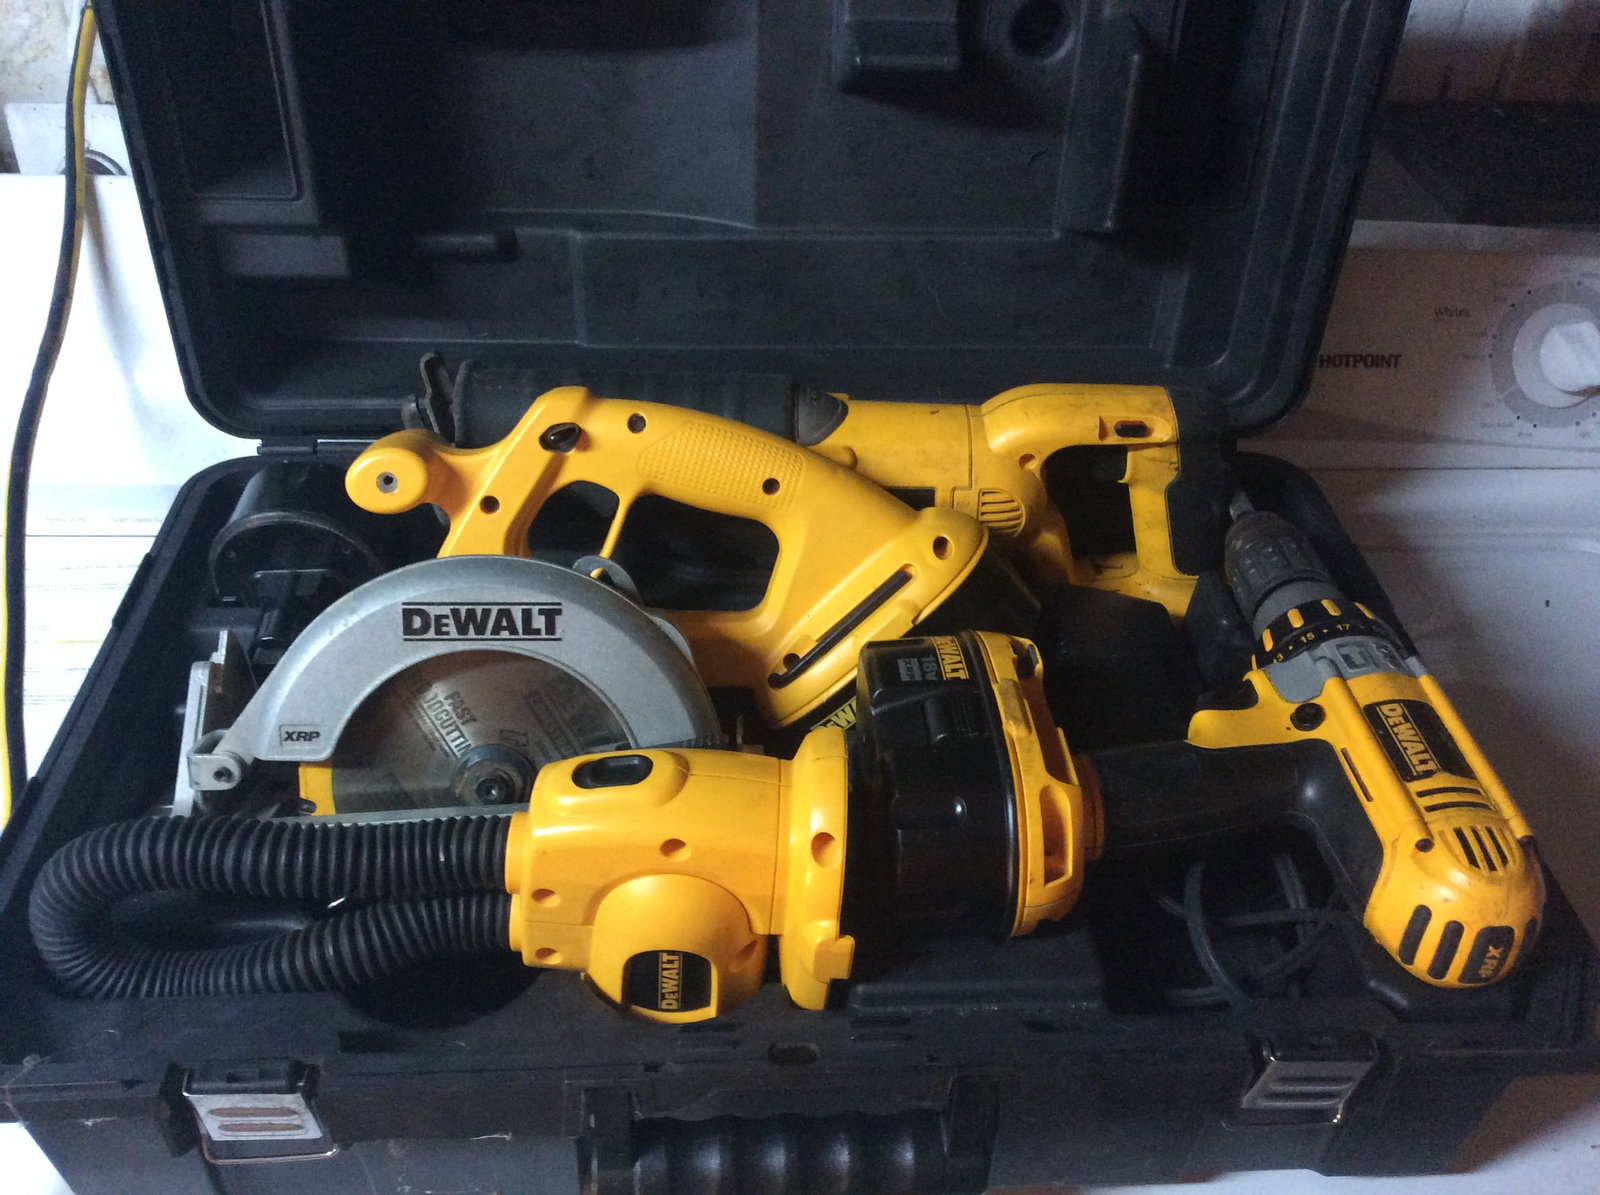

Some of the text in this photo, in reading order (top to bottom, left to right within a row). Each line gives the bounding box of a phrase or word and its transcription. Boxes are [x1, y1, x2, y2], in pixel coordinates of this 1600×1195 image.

[1319, 354, 1402, 368] HOTPOINT
[1300, 631, 1315, 643] 15
[1336, 623, 1351, 631] 17
[921, 654, 938, 680] 18V
[444, 690, 477, 726] FAST
[282, 730, 321, 742] XRP
